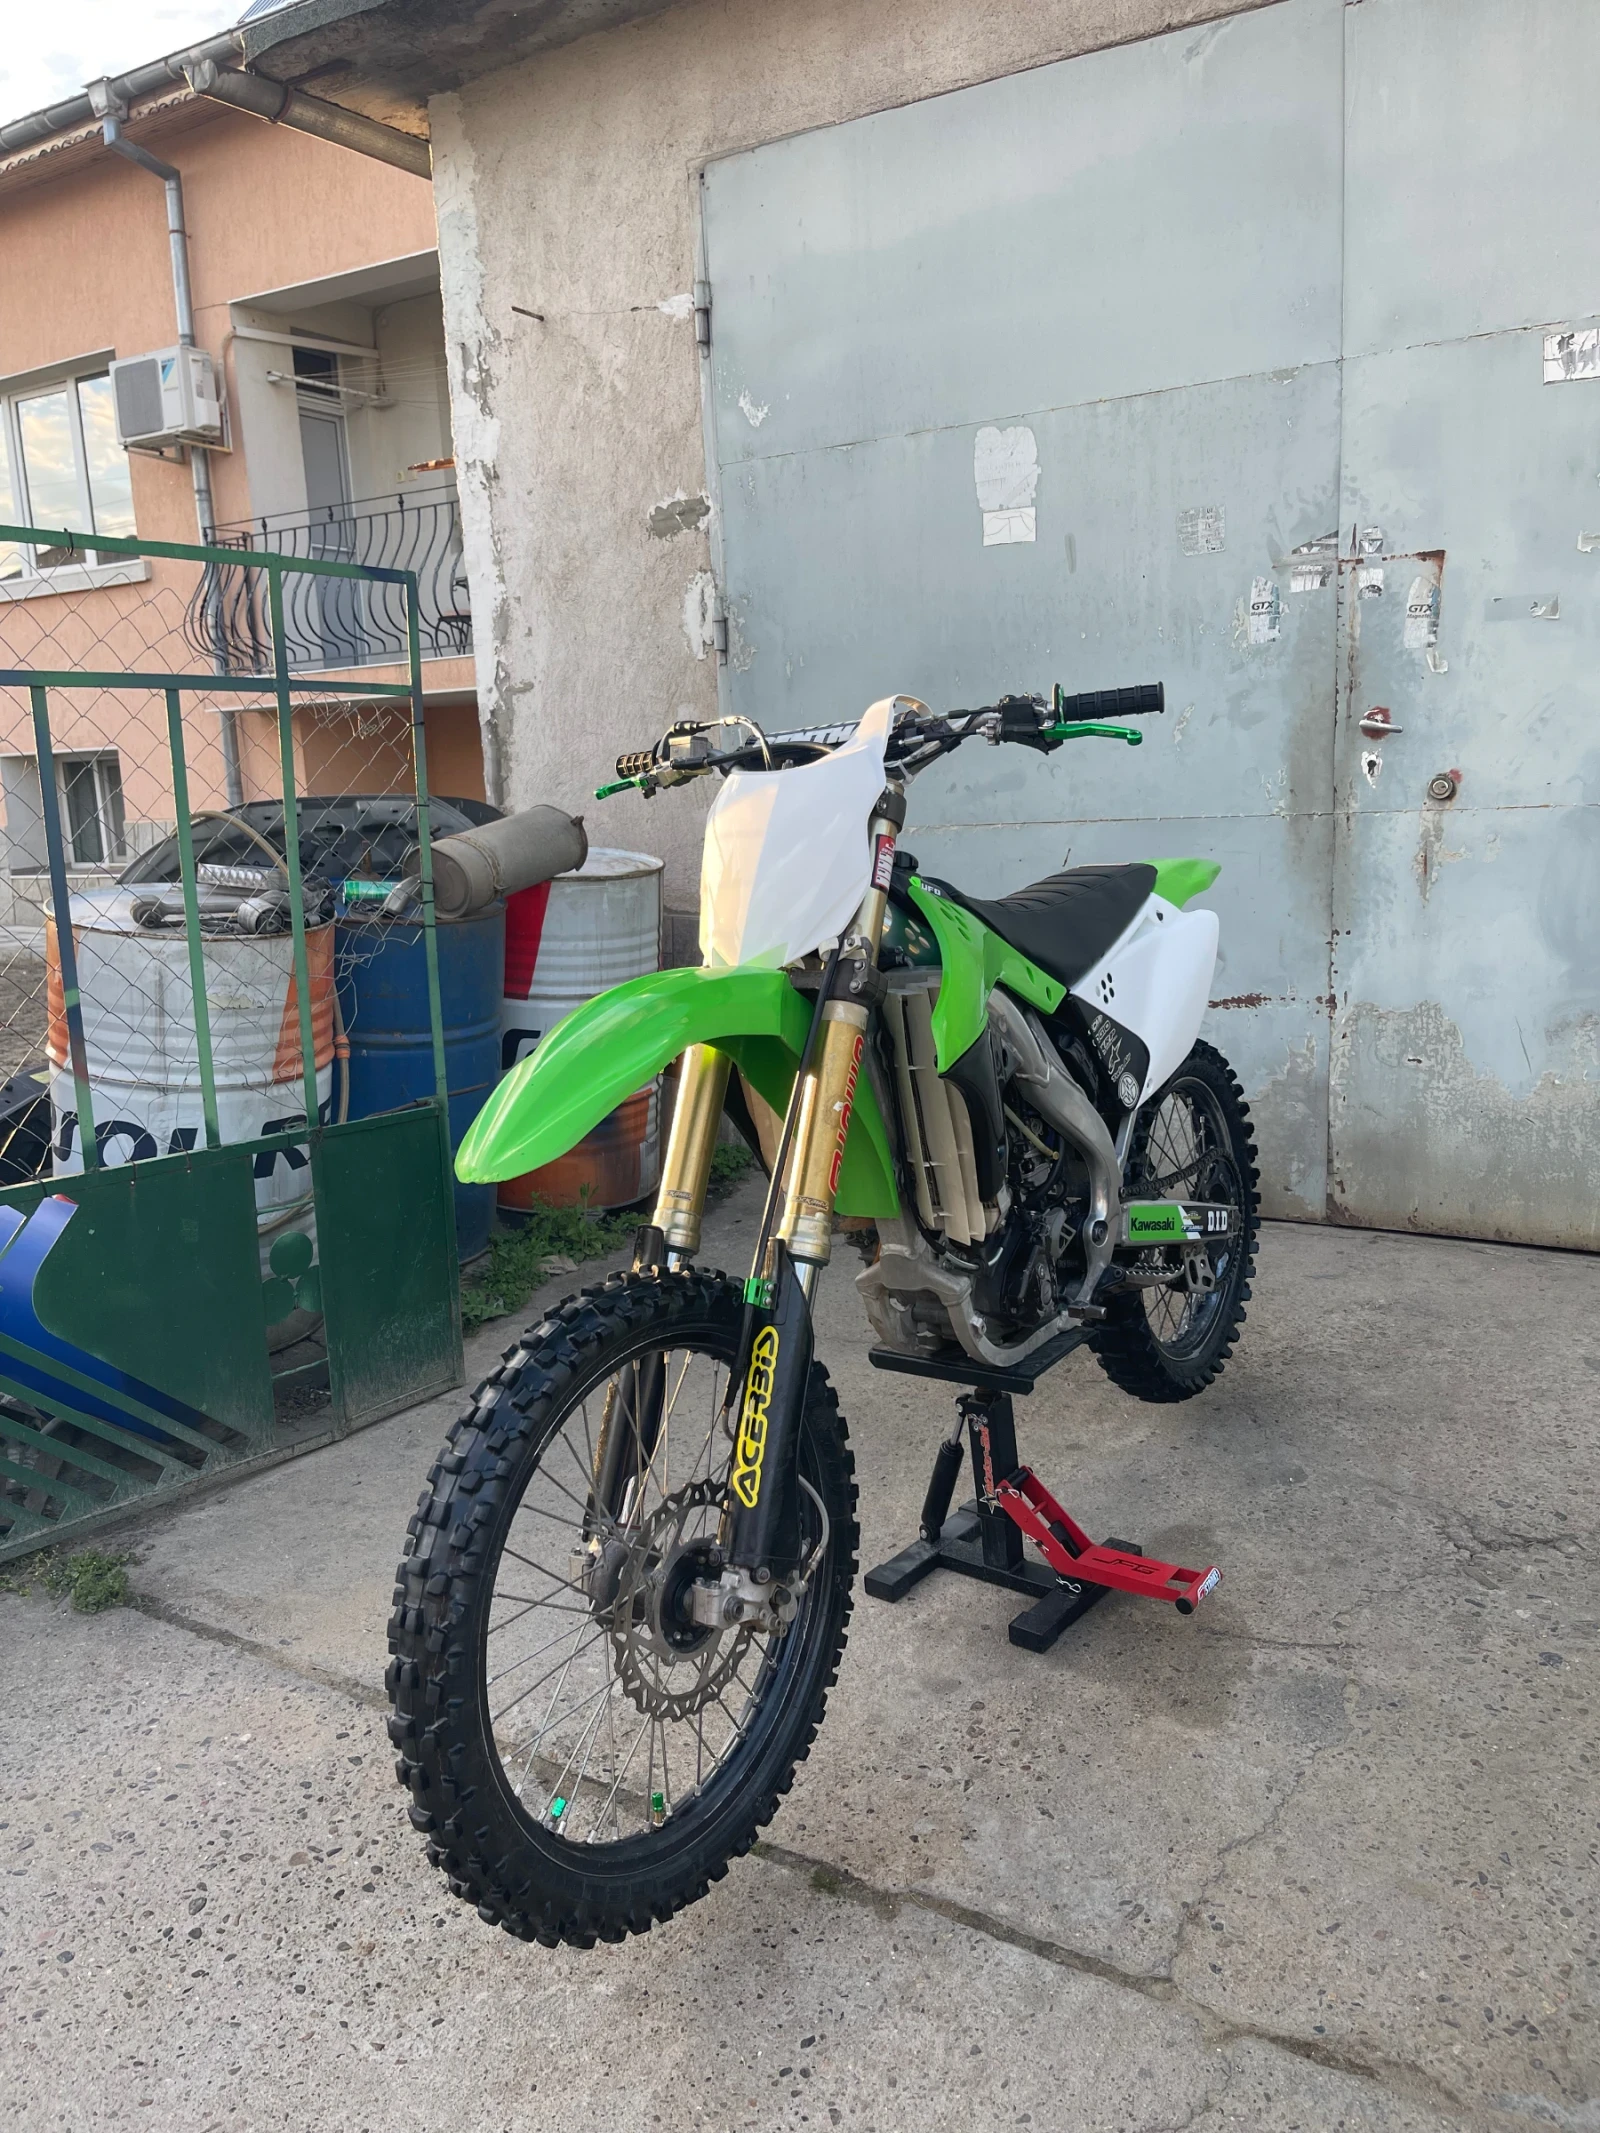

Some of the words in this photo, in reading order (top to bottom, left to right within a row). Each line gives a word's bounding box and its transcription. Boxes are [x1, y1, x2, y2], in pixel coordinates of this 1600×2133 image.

[1252, 600, 1275, 610] GTX
[1409, 604, 1434, 613] GTX
[921, 883, 941, 896] UFO
[1130, 1218, 1175, 1231] Kawasaki
[734, 1327, 779, 1507] ACERBIS
